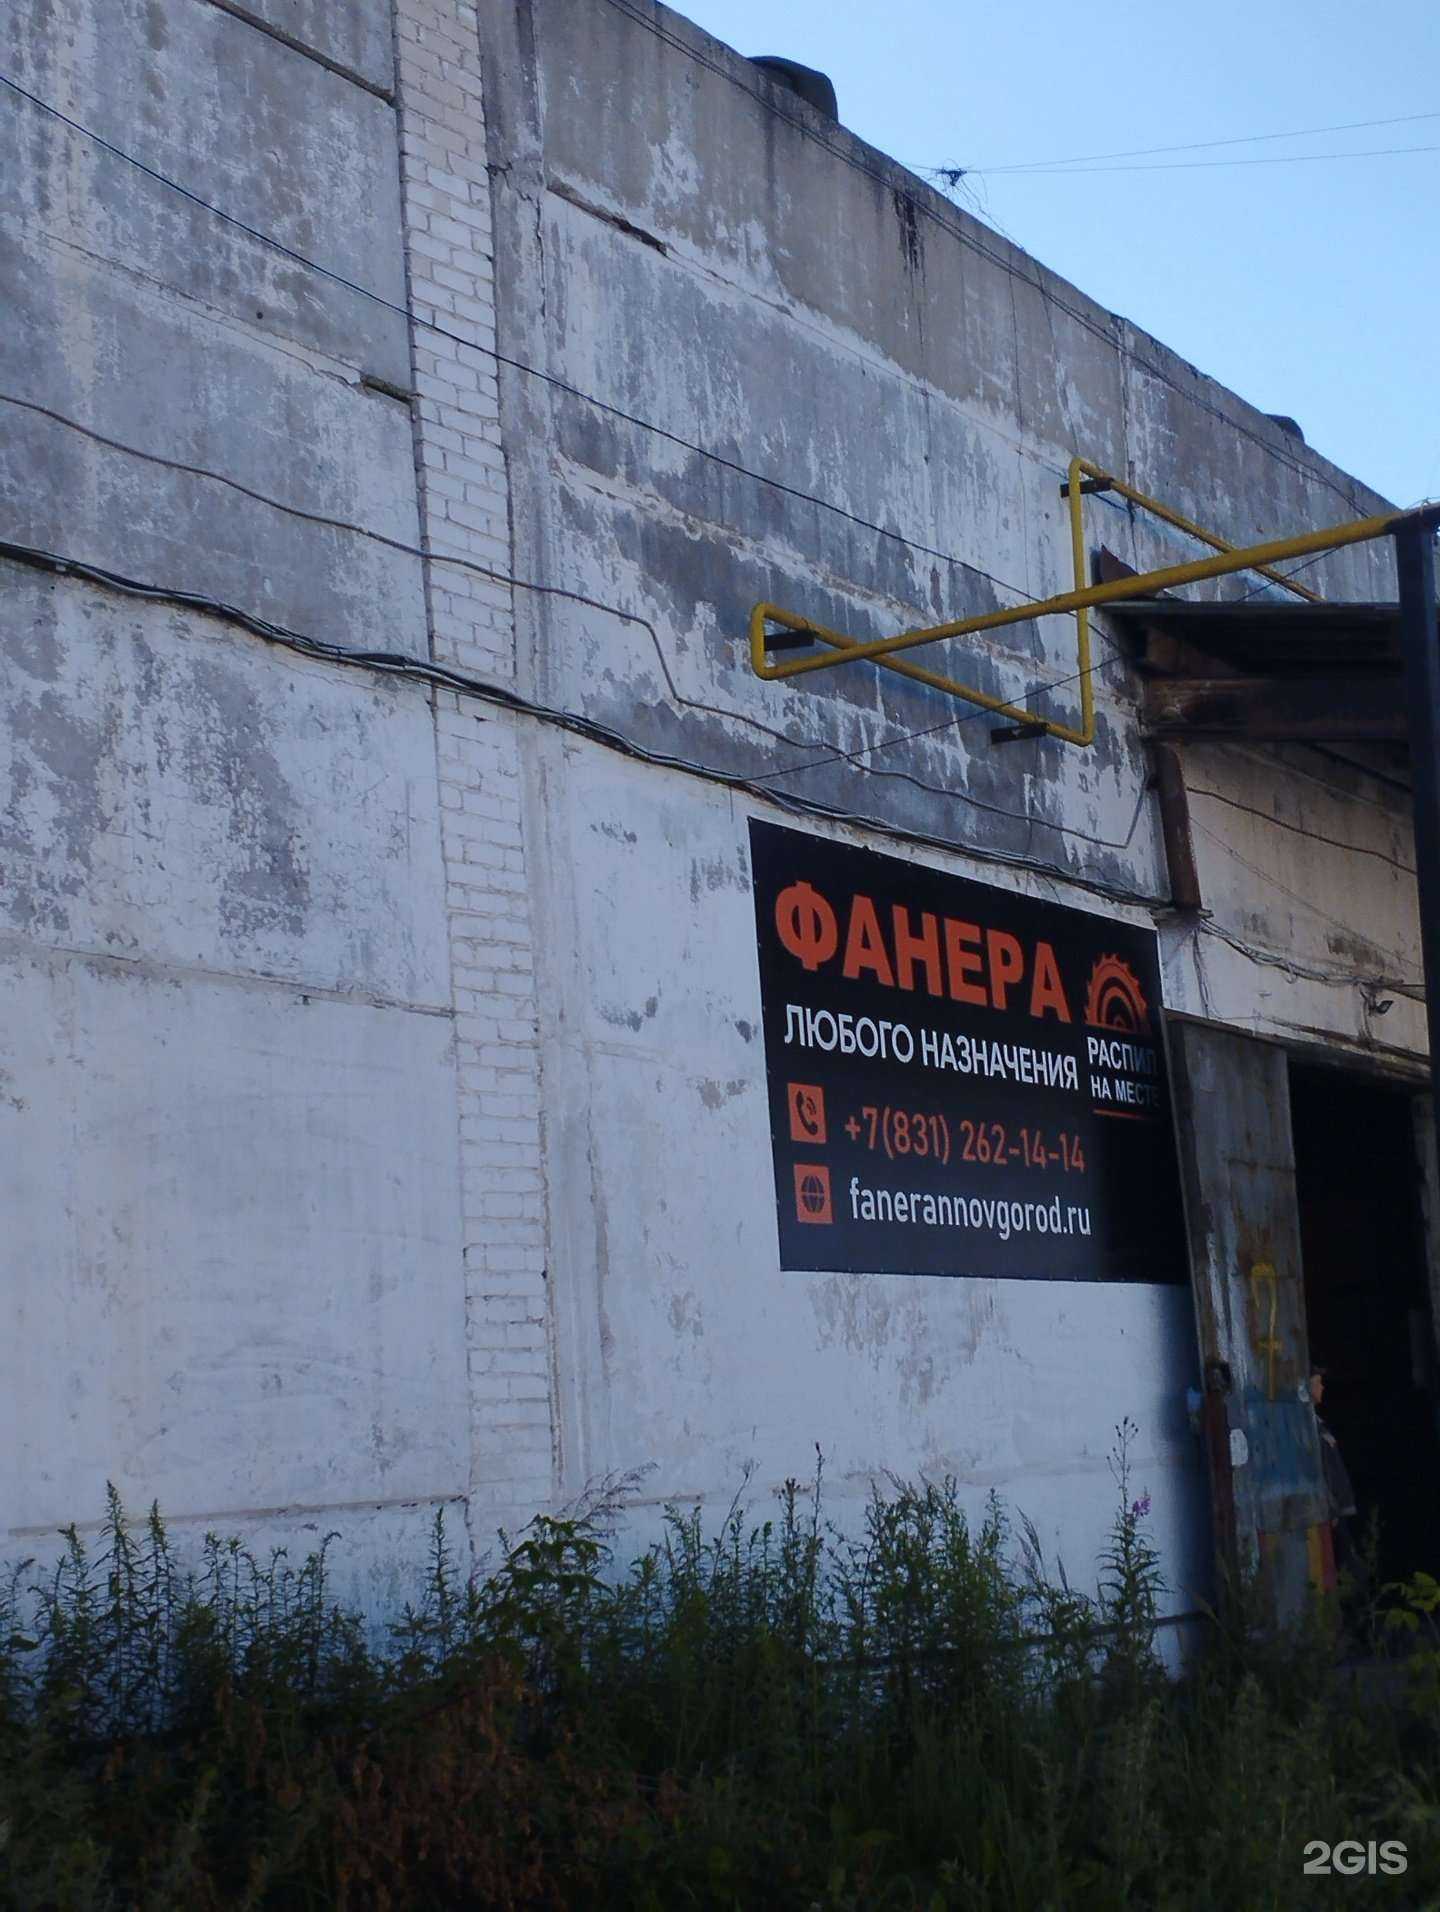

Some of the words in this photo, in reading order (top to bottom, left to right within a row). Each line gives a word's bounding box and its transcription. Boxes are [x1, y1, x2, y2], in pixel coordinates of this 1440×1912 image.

[775, 880, 1072, 1023] ФАНЕРА
[784, 1004, 914, 1063] ЛЮБОГО
[920, 1028, 1080, 1090] НАЗНАЧЕНИЯ
[1090, 1075, 1112, 1100] НА
[844, 1105, 951, 1166] +7(831)
[959, 1119, 1086, 1174] 262-14-14
[850, 1177, 1092, 1240] fanerannovgorod.ru
